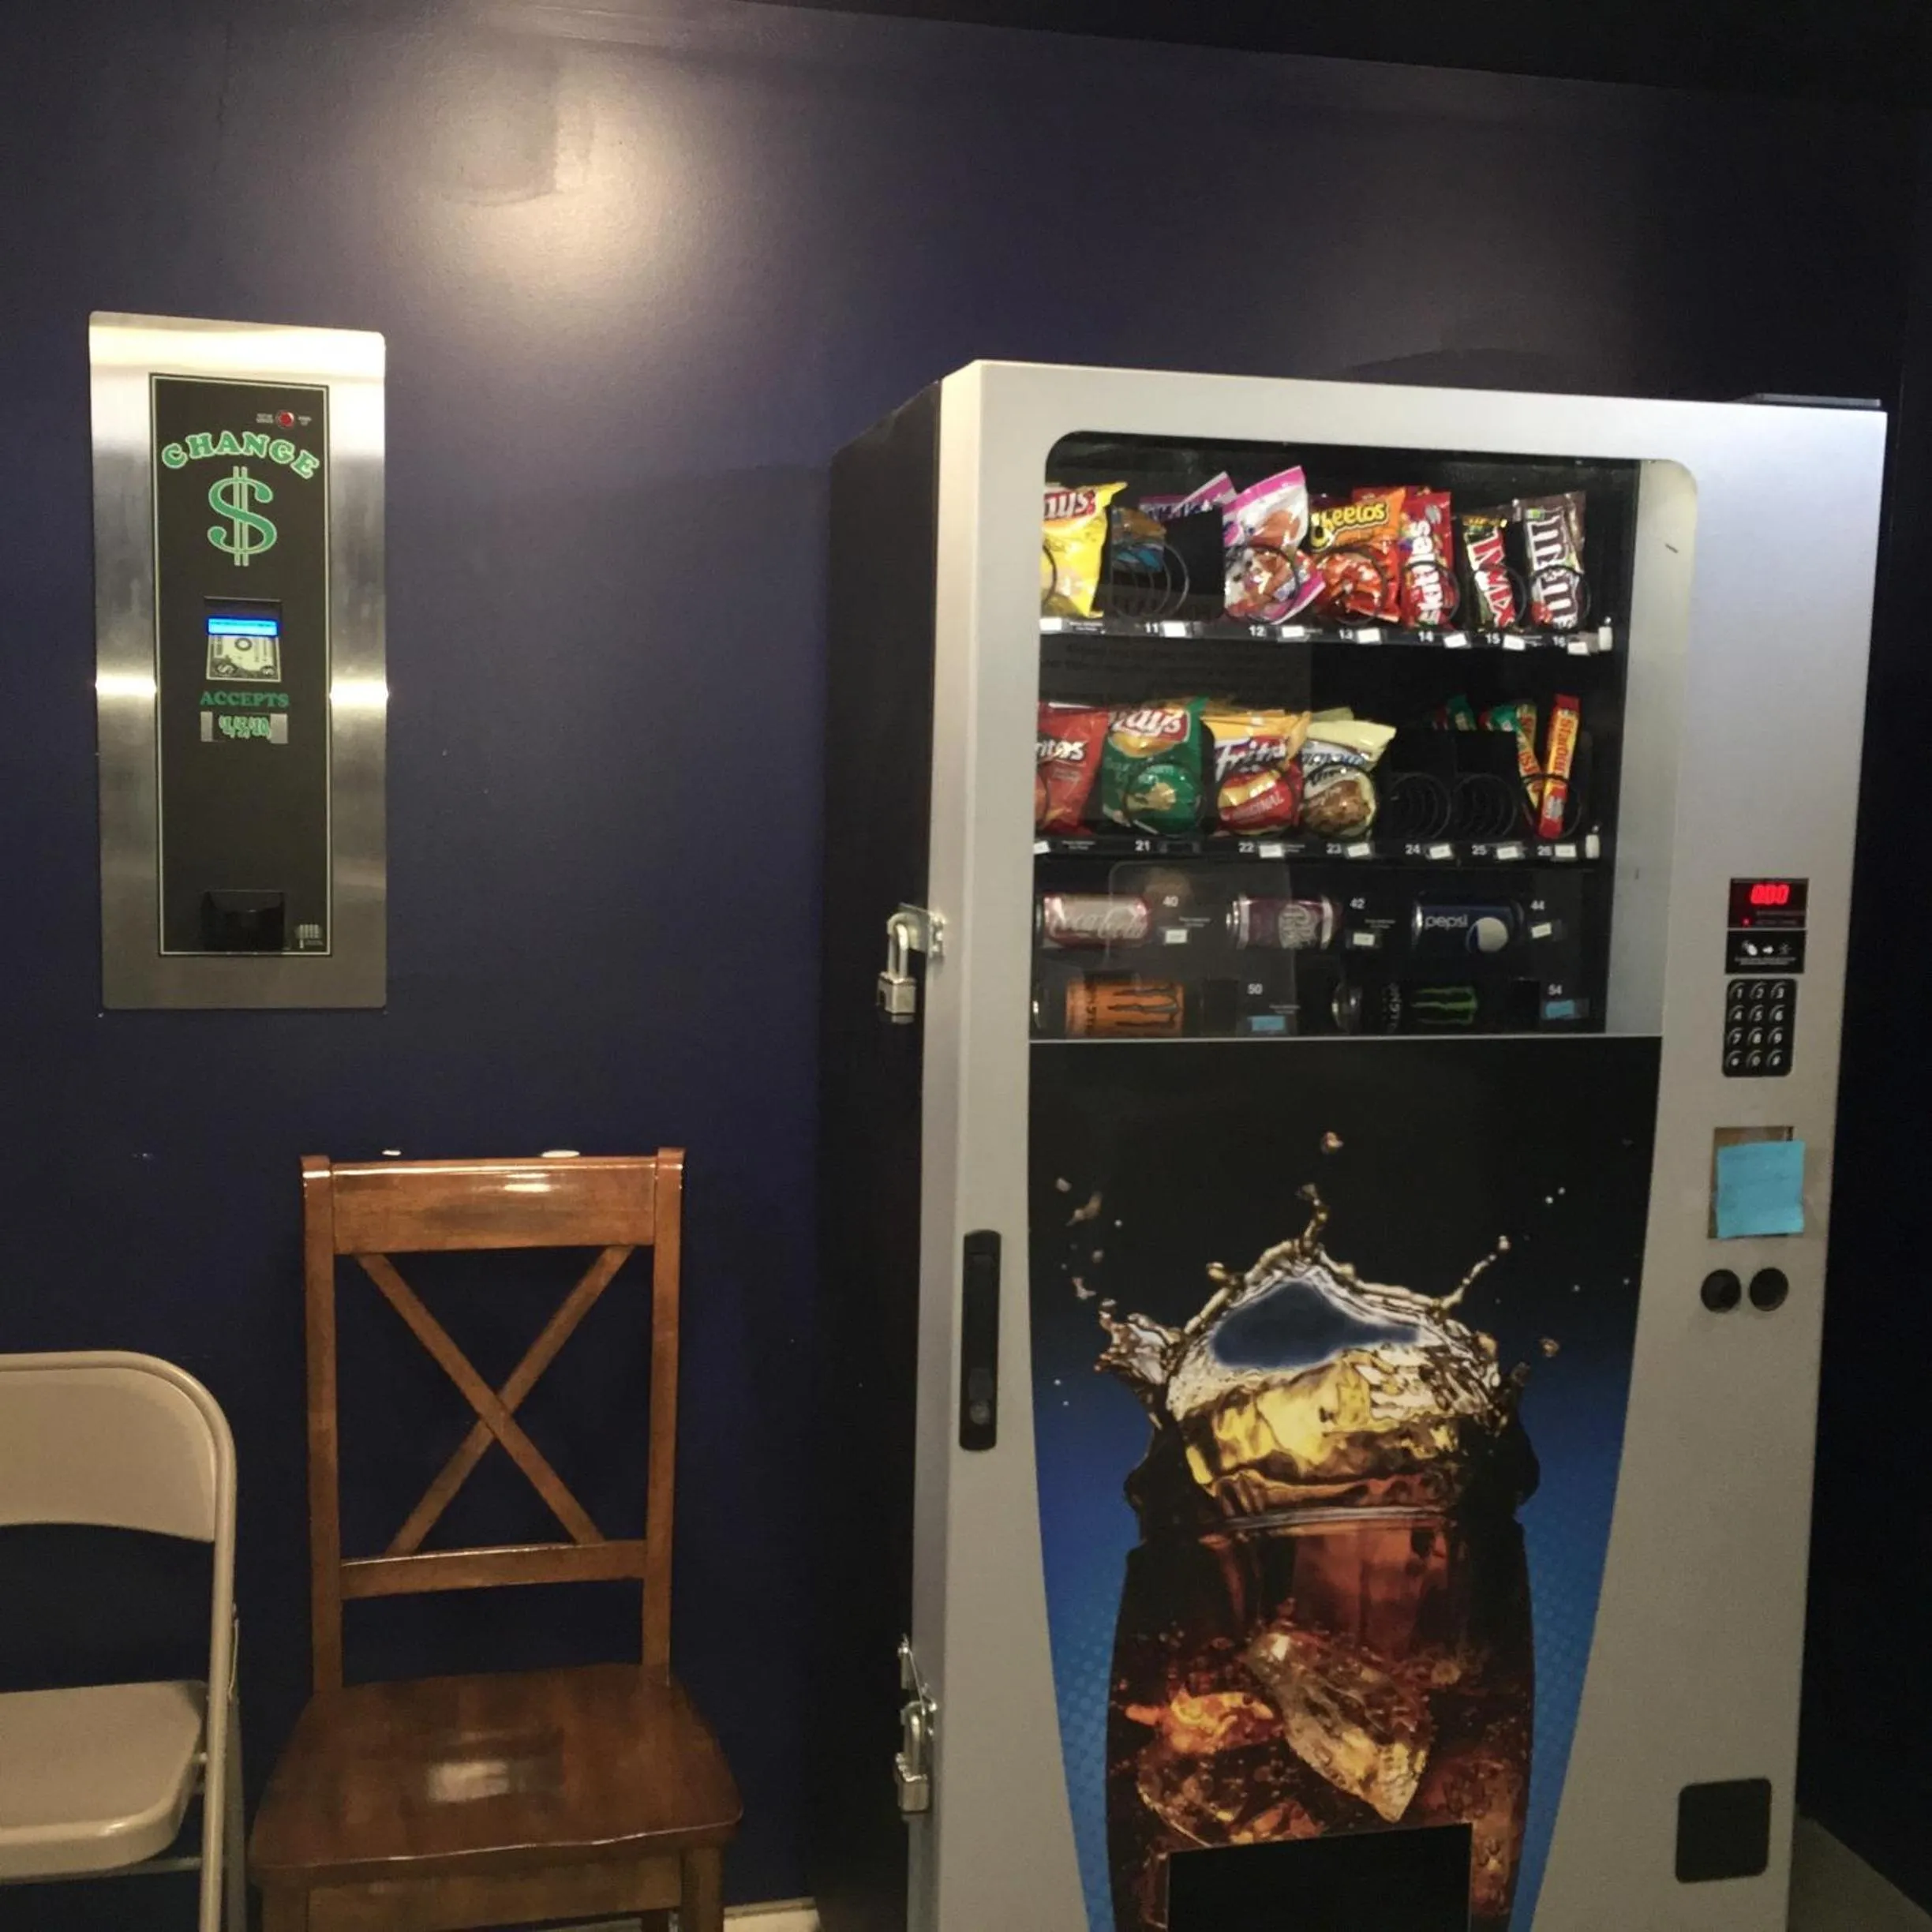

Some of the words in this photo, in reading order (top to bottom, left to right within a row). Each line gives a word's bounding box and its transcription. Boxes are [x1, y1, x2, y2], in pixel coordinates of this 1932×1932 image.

[162, 431, 320, 479] CHANGE
[1311, 503, 1385, 548] Cheetos
[1249, 625, 1266, 637] 12
[1339, 629, 1354, 639] 13
[1419, 630, 1433, 642] 14
[1486, 632, 1500, 644] 15
[200, 691, 290, 708] ACCEPTS
[1135, 841, 1150, 851] 21
[1239, 843, 1255, 852] 22
[1326, 844, 1341, 854] 23
[1406, 844, 1421, 855] 24
[1472, 845, 1487, 856] 25
[1537, 845, 1552, 856] 26
[1163, 897, 1178, 907] 40
[1530, 900, 1544, 911] 44
[1425, 914, 1468, 930] pepsi
[1248, 983, 1263, 994] 50
[1548, 985, 1562, 995] 54
